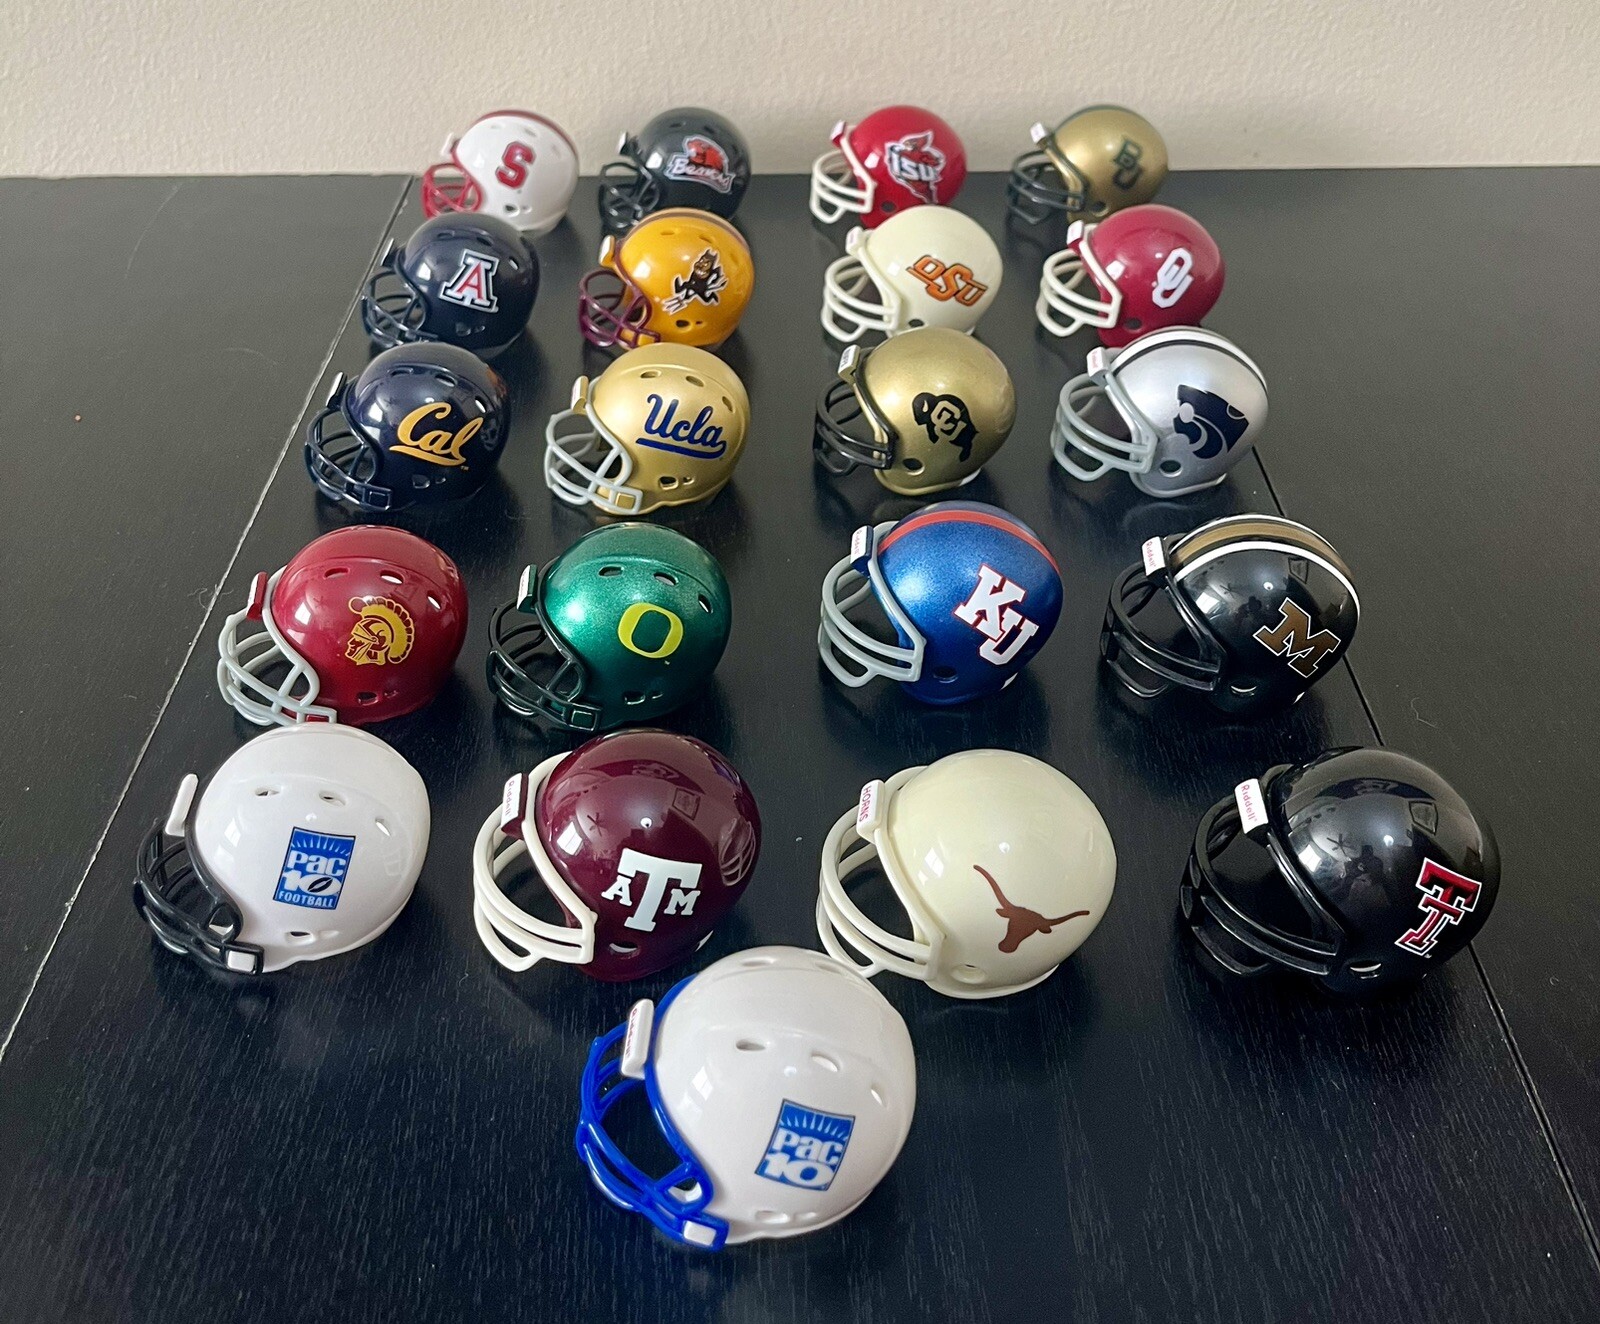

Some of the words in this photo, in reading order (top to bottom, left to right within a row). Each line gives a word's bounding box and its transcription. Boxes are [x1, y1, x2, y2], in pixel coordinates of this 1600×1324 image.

[495, 141, 536, 189] S
[890, 150, 937, 182] ISU
[439, 249, 500, 314] A
[905, 254, 989, 307] OSU
[389, 402, 484, 467] Cal
[617, 602, 684, 659] O
[952, 563, 1039, 665] KU
[1253, 596, 1341, 678] M
[859, 785, 872, 822] HORNS
[278, 890, 335, 908] FOOTBALL
[282, 869, 342, 897] 10
[764, 1152, 836, 1187] 10
